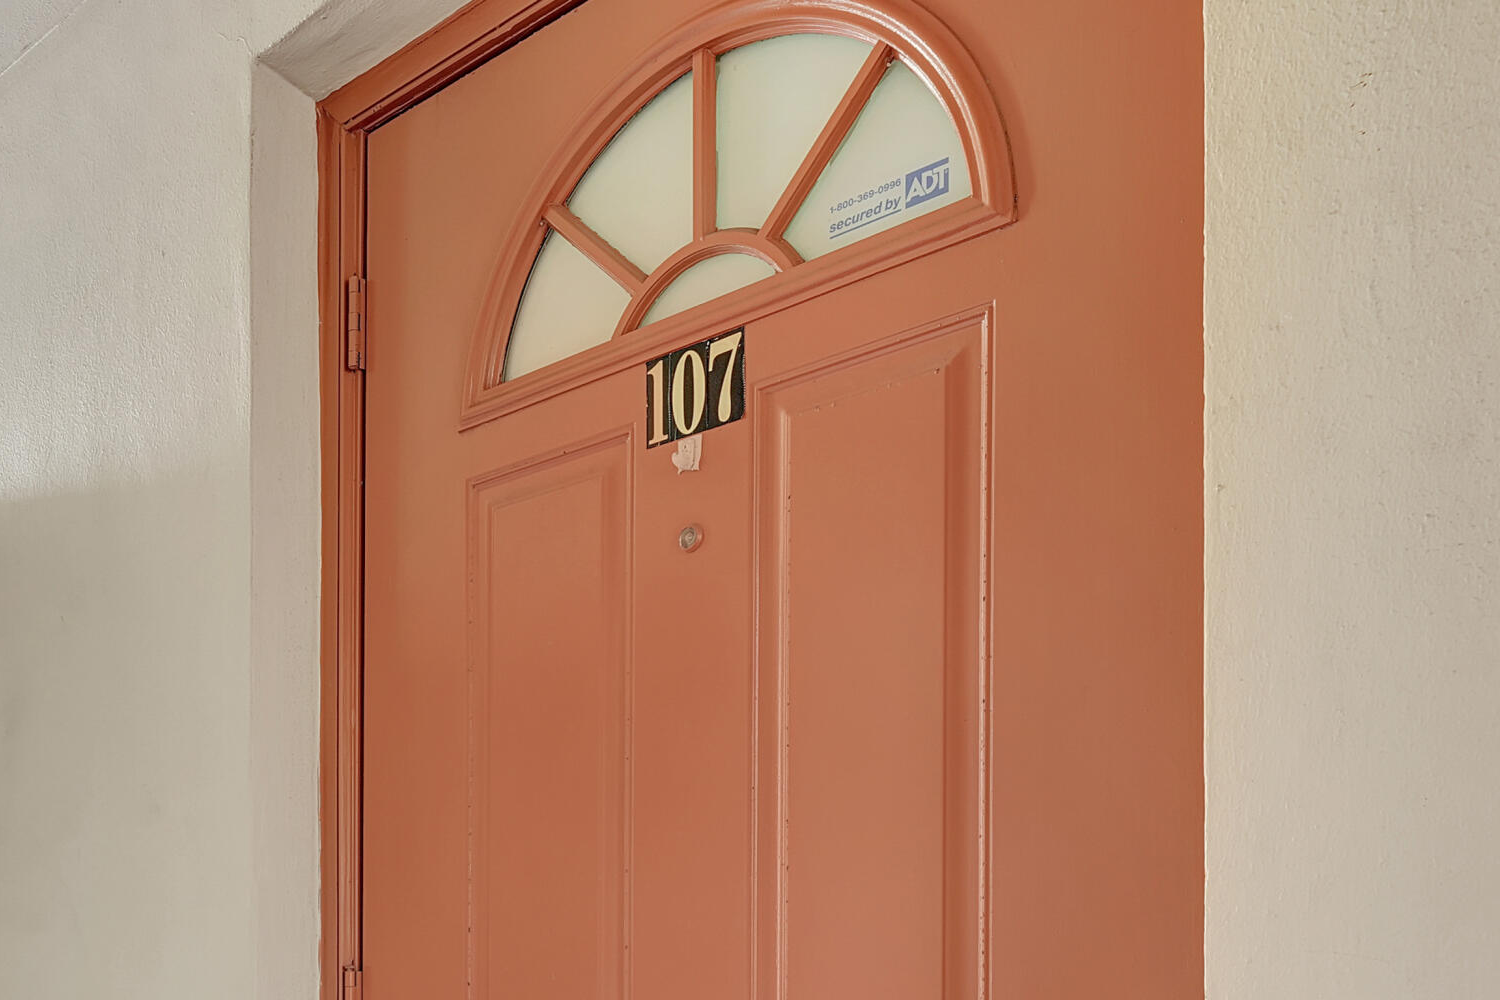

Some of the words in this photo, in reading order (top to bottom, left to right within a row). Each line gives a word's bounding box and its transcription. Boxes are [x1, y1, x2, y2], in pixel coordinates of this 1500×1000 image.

[830, 178, 901, 214] 1-800-369-0996
[905, 165, 948, 202] ADT
[830, 203, 882, 233] secured
[885, 195, 901, 212] by
[647, 331, 742, 445] 107
